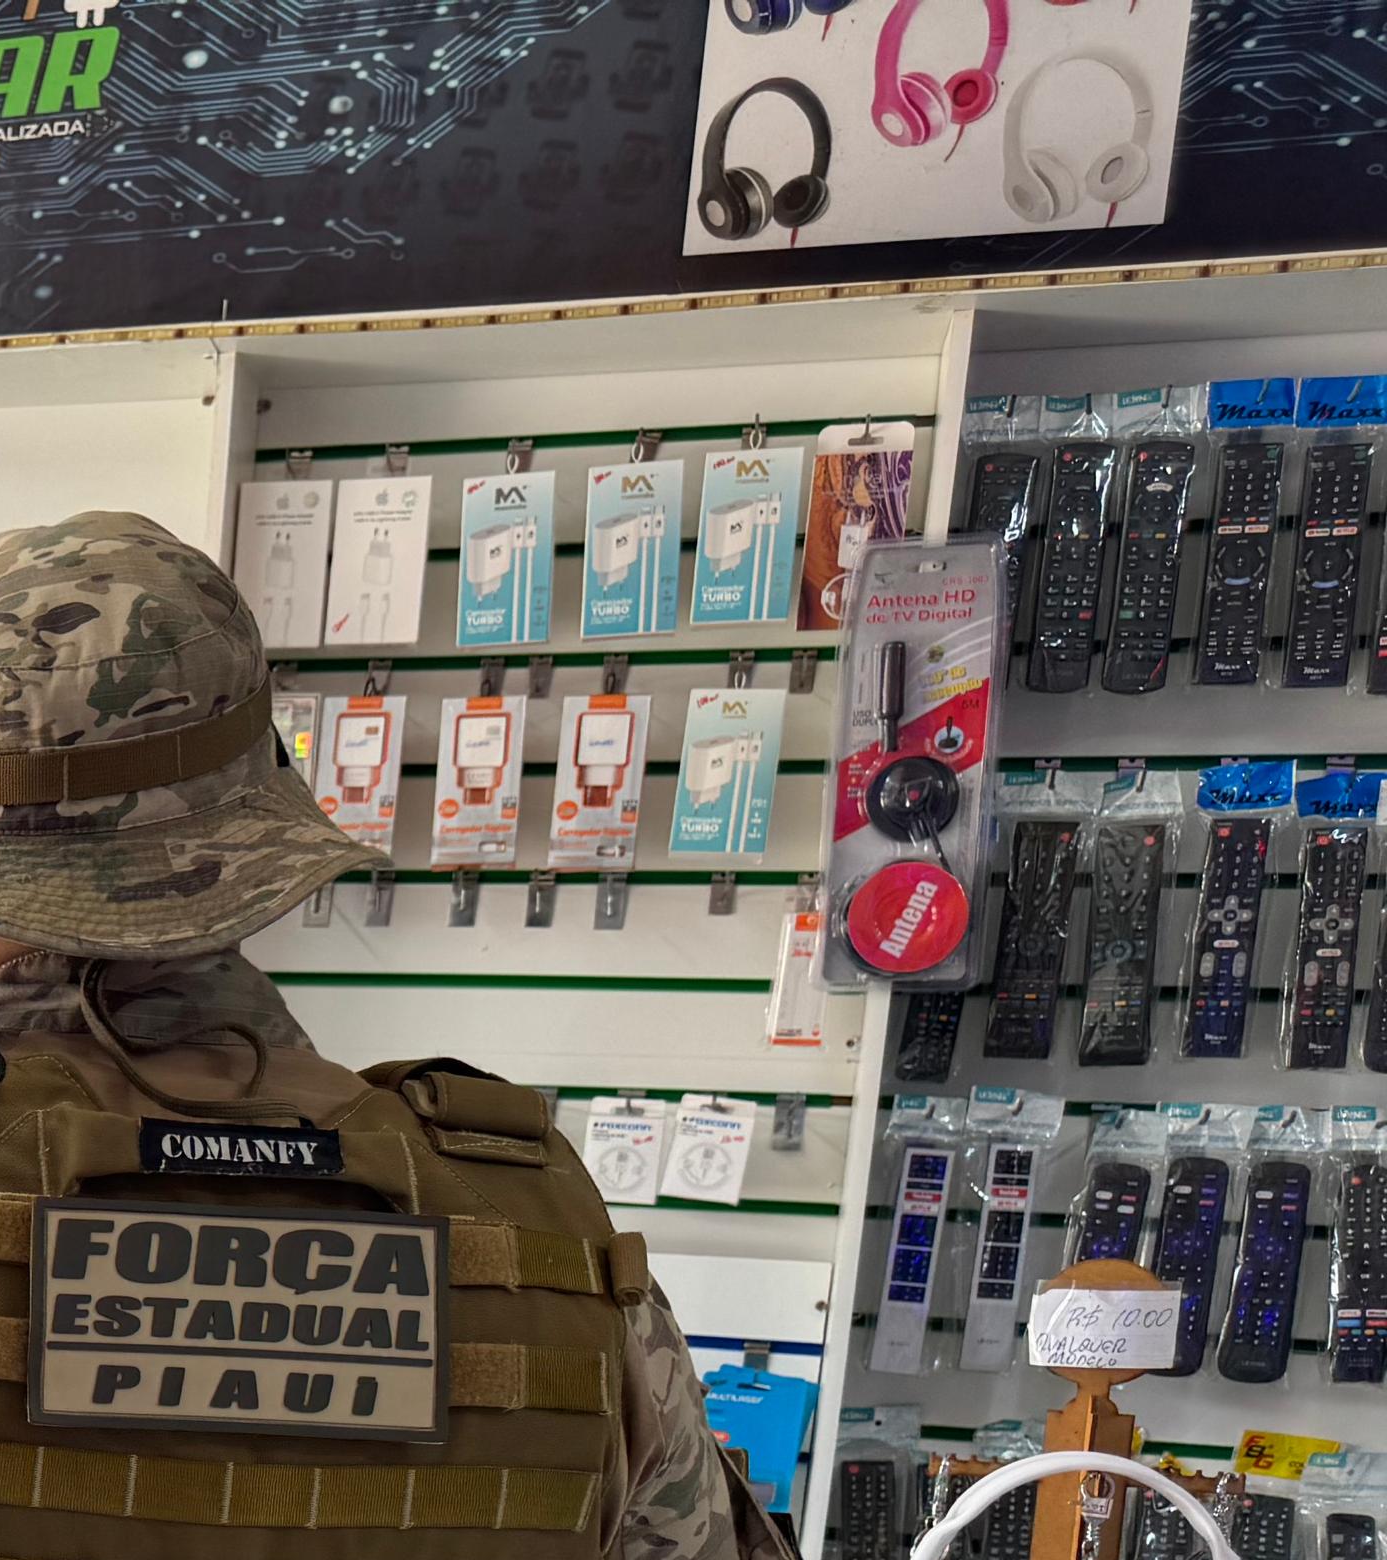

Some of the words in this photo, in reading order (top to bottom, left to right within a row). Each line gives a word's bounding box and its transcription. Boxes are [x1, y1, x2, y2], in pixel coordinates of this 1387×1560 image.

[1216, 402, 1292, 421] Maxx
[1308, 400, 1384, 421] Maxx
[867, 594, 940, 609] Antena
[944, 589, 977, 604] HD
[866, 614, 887, 625] de
[894, 610, 915, 624] TV
[918, 607, 973, 625] Digital
[852, 718, 882, 728] DUPL
[879, 880, 939, 959] Antena
[161, 1132, 319, 1167] COMANFY
[51, 1217, 431, 1297] FORÇA
[51, 1293, 431, 1352] ESTADUAL
[1066, 1304, 1103, 1331] R$
[1112, 1307, 1174, 1330] 10.00
